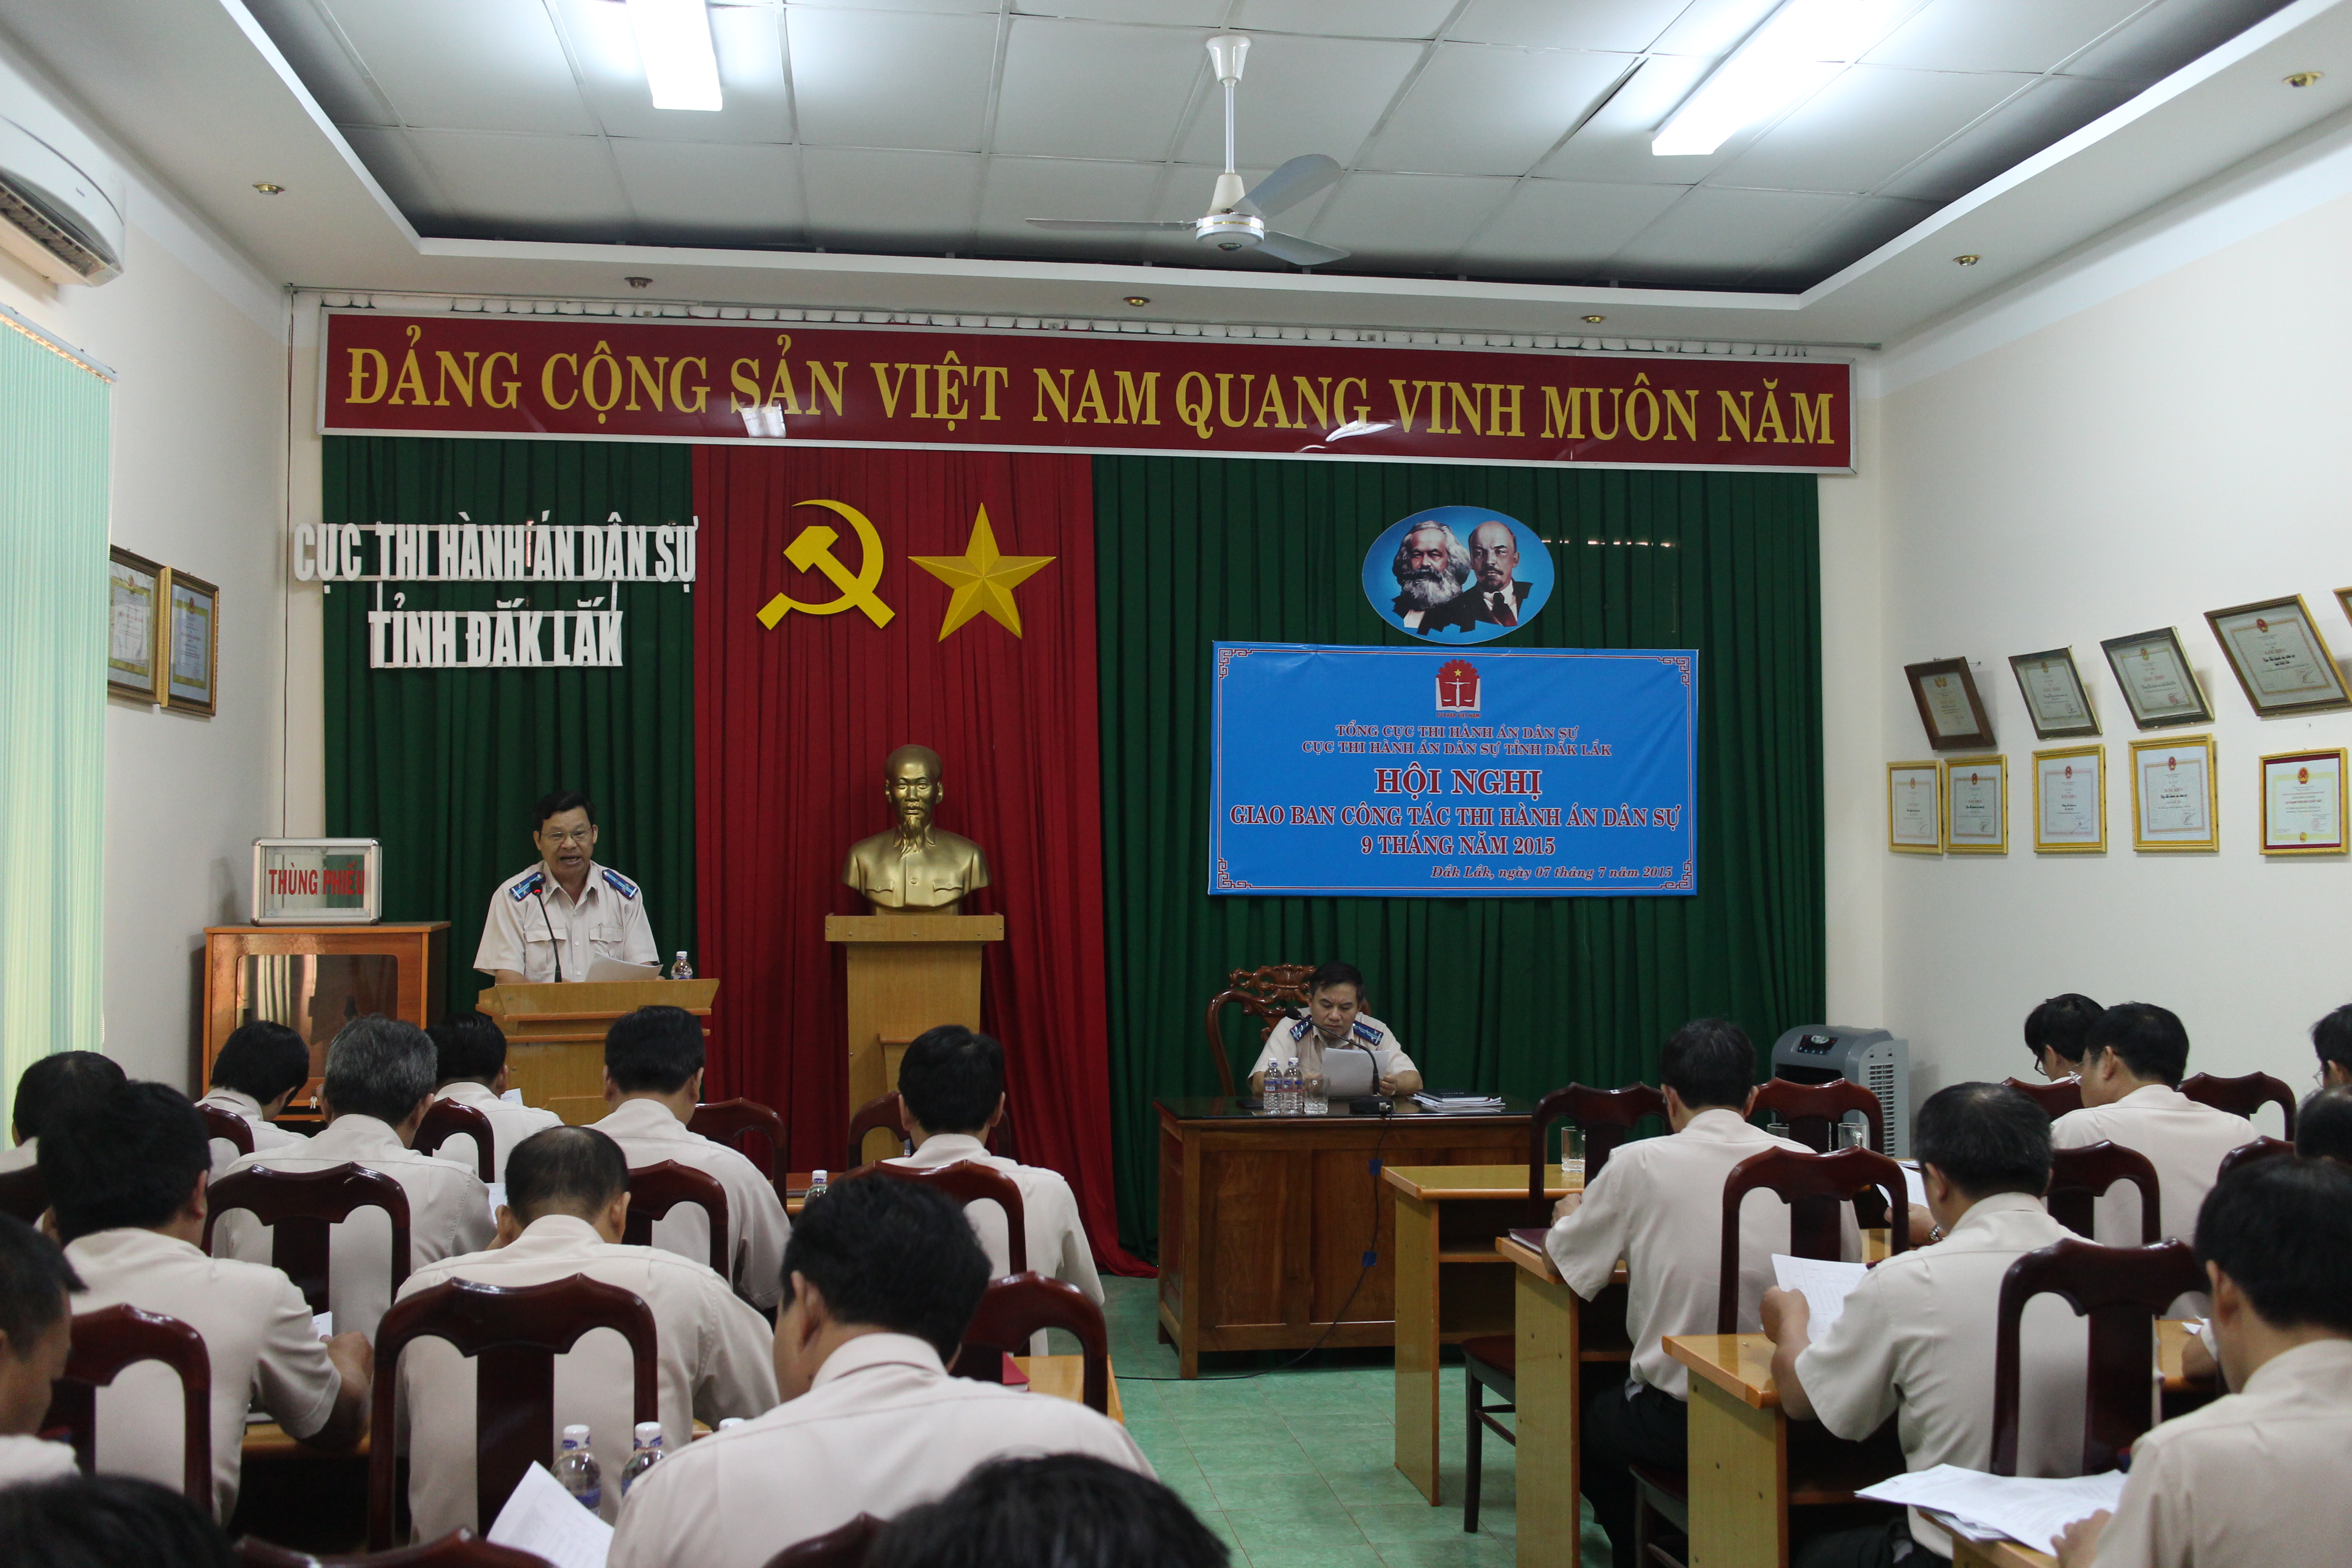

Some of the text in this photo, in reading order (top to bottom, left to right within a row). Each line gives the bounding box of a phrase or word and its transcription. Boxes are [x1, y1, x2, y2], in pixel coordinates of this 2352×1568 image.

[346, 325, 1834, 444] ĐẢNG CỘNG SẢN VIỆT NAM QUANG VINH MUÔN NĂM
[294, 510, 699, 594] CỤC THI HÀNH ÁN DÂN SỰ
[368, 592, 623, 667] TỈNH ĐẮK LẮK
[1335, 720, 1579, 741] TỔNG CỤC THI HÀNH ÁN DÂN SỰ
[1302, 740, 1334, 755] CỤC
[1338, 741, 1365, 753] THI
[1369, 739, 1414, 754] HÀNH
[1417, 740, 1440, 754] ÁN
[1443, 740, 1476, 755] DÂN
[1480, 741, 1501, 757] SỰ
[1504, 739, 1541, 755] TỈNH
[1374, 761, 1543, 801] HỘI NGHỊ
[1230, 801, 1681, 831] GIAO BAN CÔNG TÁC THI HÀNH ÁN DÂN SỰ
[1361, 830, 1555, 855] 9 THÁNG NĂM 2015
[269, 860, 365, 895] THÙNG PHIẾU
[1431, 864, 1460, 878] Đắk
[1498, 867, 1532, 880] ngày
[1535, 866, 1551, 878] 07
[1554, 865, 1594, 880] tháng
[1597, 867, 1605, 878] 7
[1609, 866, 1640, 878] năm
[1642, 866, 1674, 878] 2015
